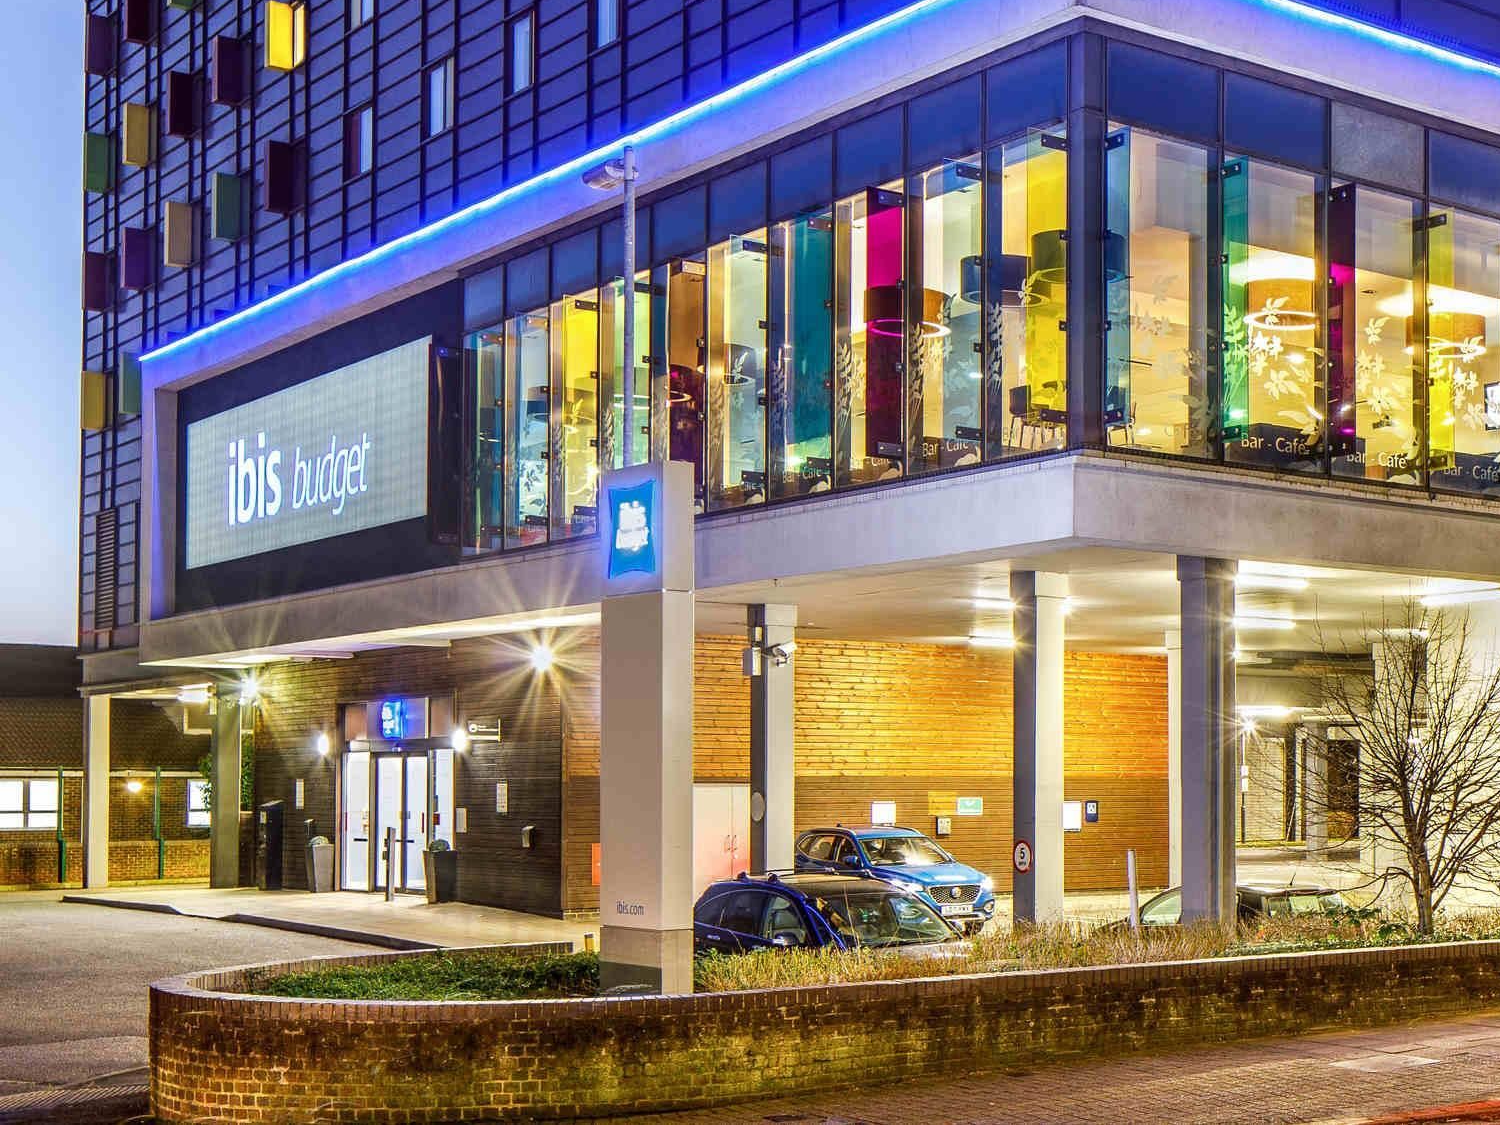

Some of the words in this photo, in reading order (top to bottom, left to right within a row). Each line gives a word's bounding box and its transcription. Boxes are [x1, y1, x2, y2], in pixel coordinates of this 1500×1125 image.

[923, 442, 938, 457] Bar
[1241, 432, 1264, 449] Bar
[1275, 437, 1306, 455] Café
[1378, 451, 1406, 469] Café
[228, 431, 283, 526] ibis
[292, 432, 371, 515] budget
[1472, 465, 1499, 482] Café
[1019, 847, 1026, 860] 5
[616, 899, 645, 916] ibis.com
